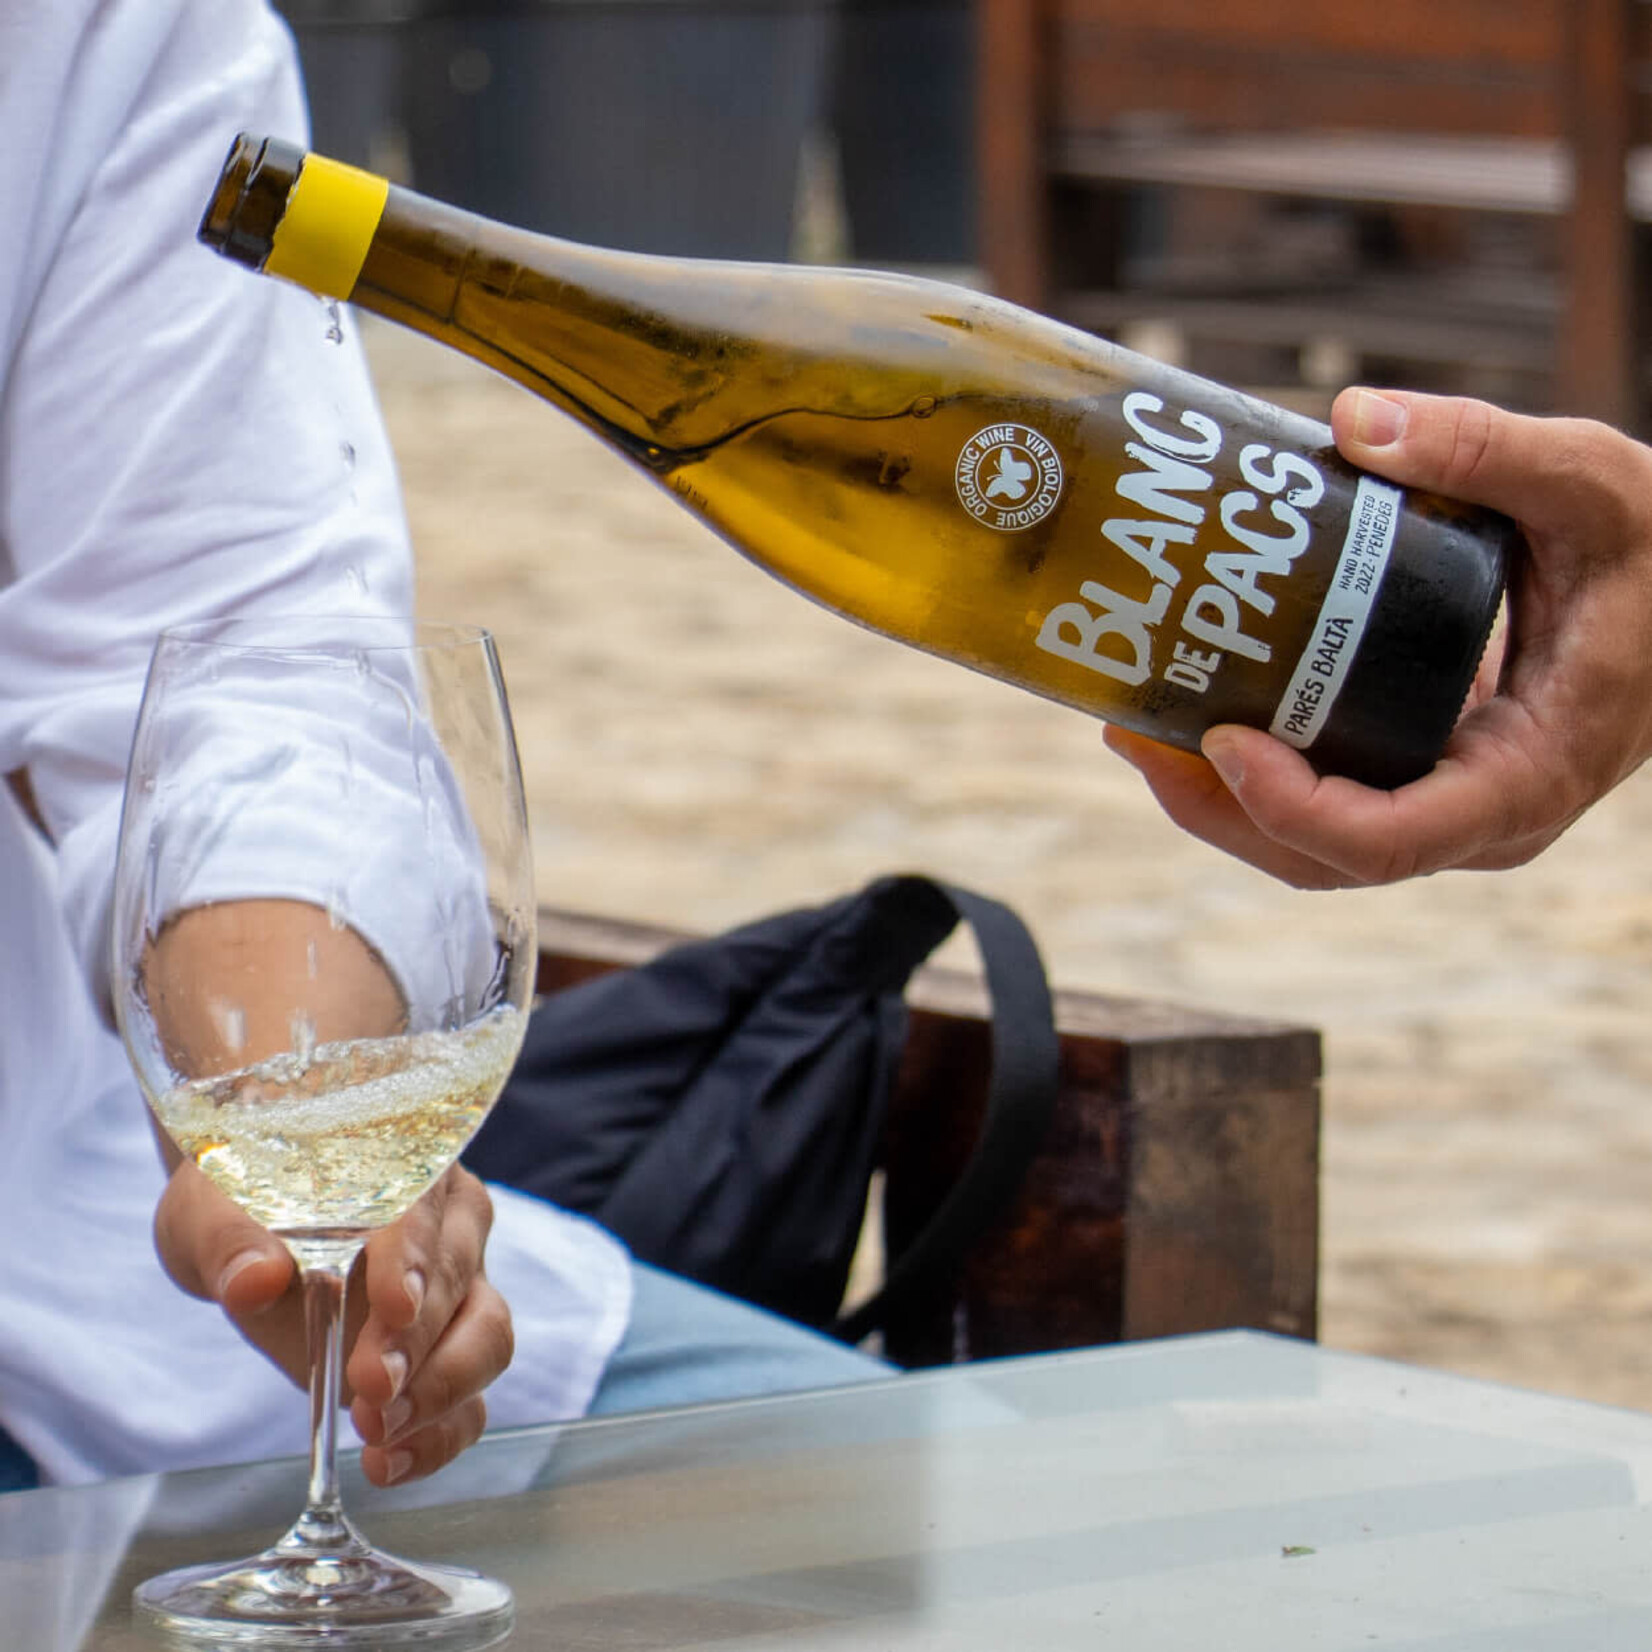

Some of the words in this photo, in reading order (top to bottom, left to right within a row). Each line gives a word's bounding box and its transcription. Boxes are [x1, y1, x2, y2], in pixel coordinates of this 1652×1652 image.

[959, 447, 987, 516] ORGANIC
[976, 427, 1015, 449] WINE
[1025, 433, 1049, 457] VIN
[996, 457, 1059, 527] BIOLOGIQUE
[1035, 391, 1222, 686] BLANC
[1181, 444, 1324, 663] PACS
[1341, 555, 1358, 590] HAND
[1350, 495, 1376, 555] HARVESTED
[1355, 565, 1376, 595] 2022
[1163, 641, 1221, 693] DE
[1284, 678, 1325, 735] PARÉS
[1312, 617, 1353, 677] BALTÀ
